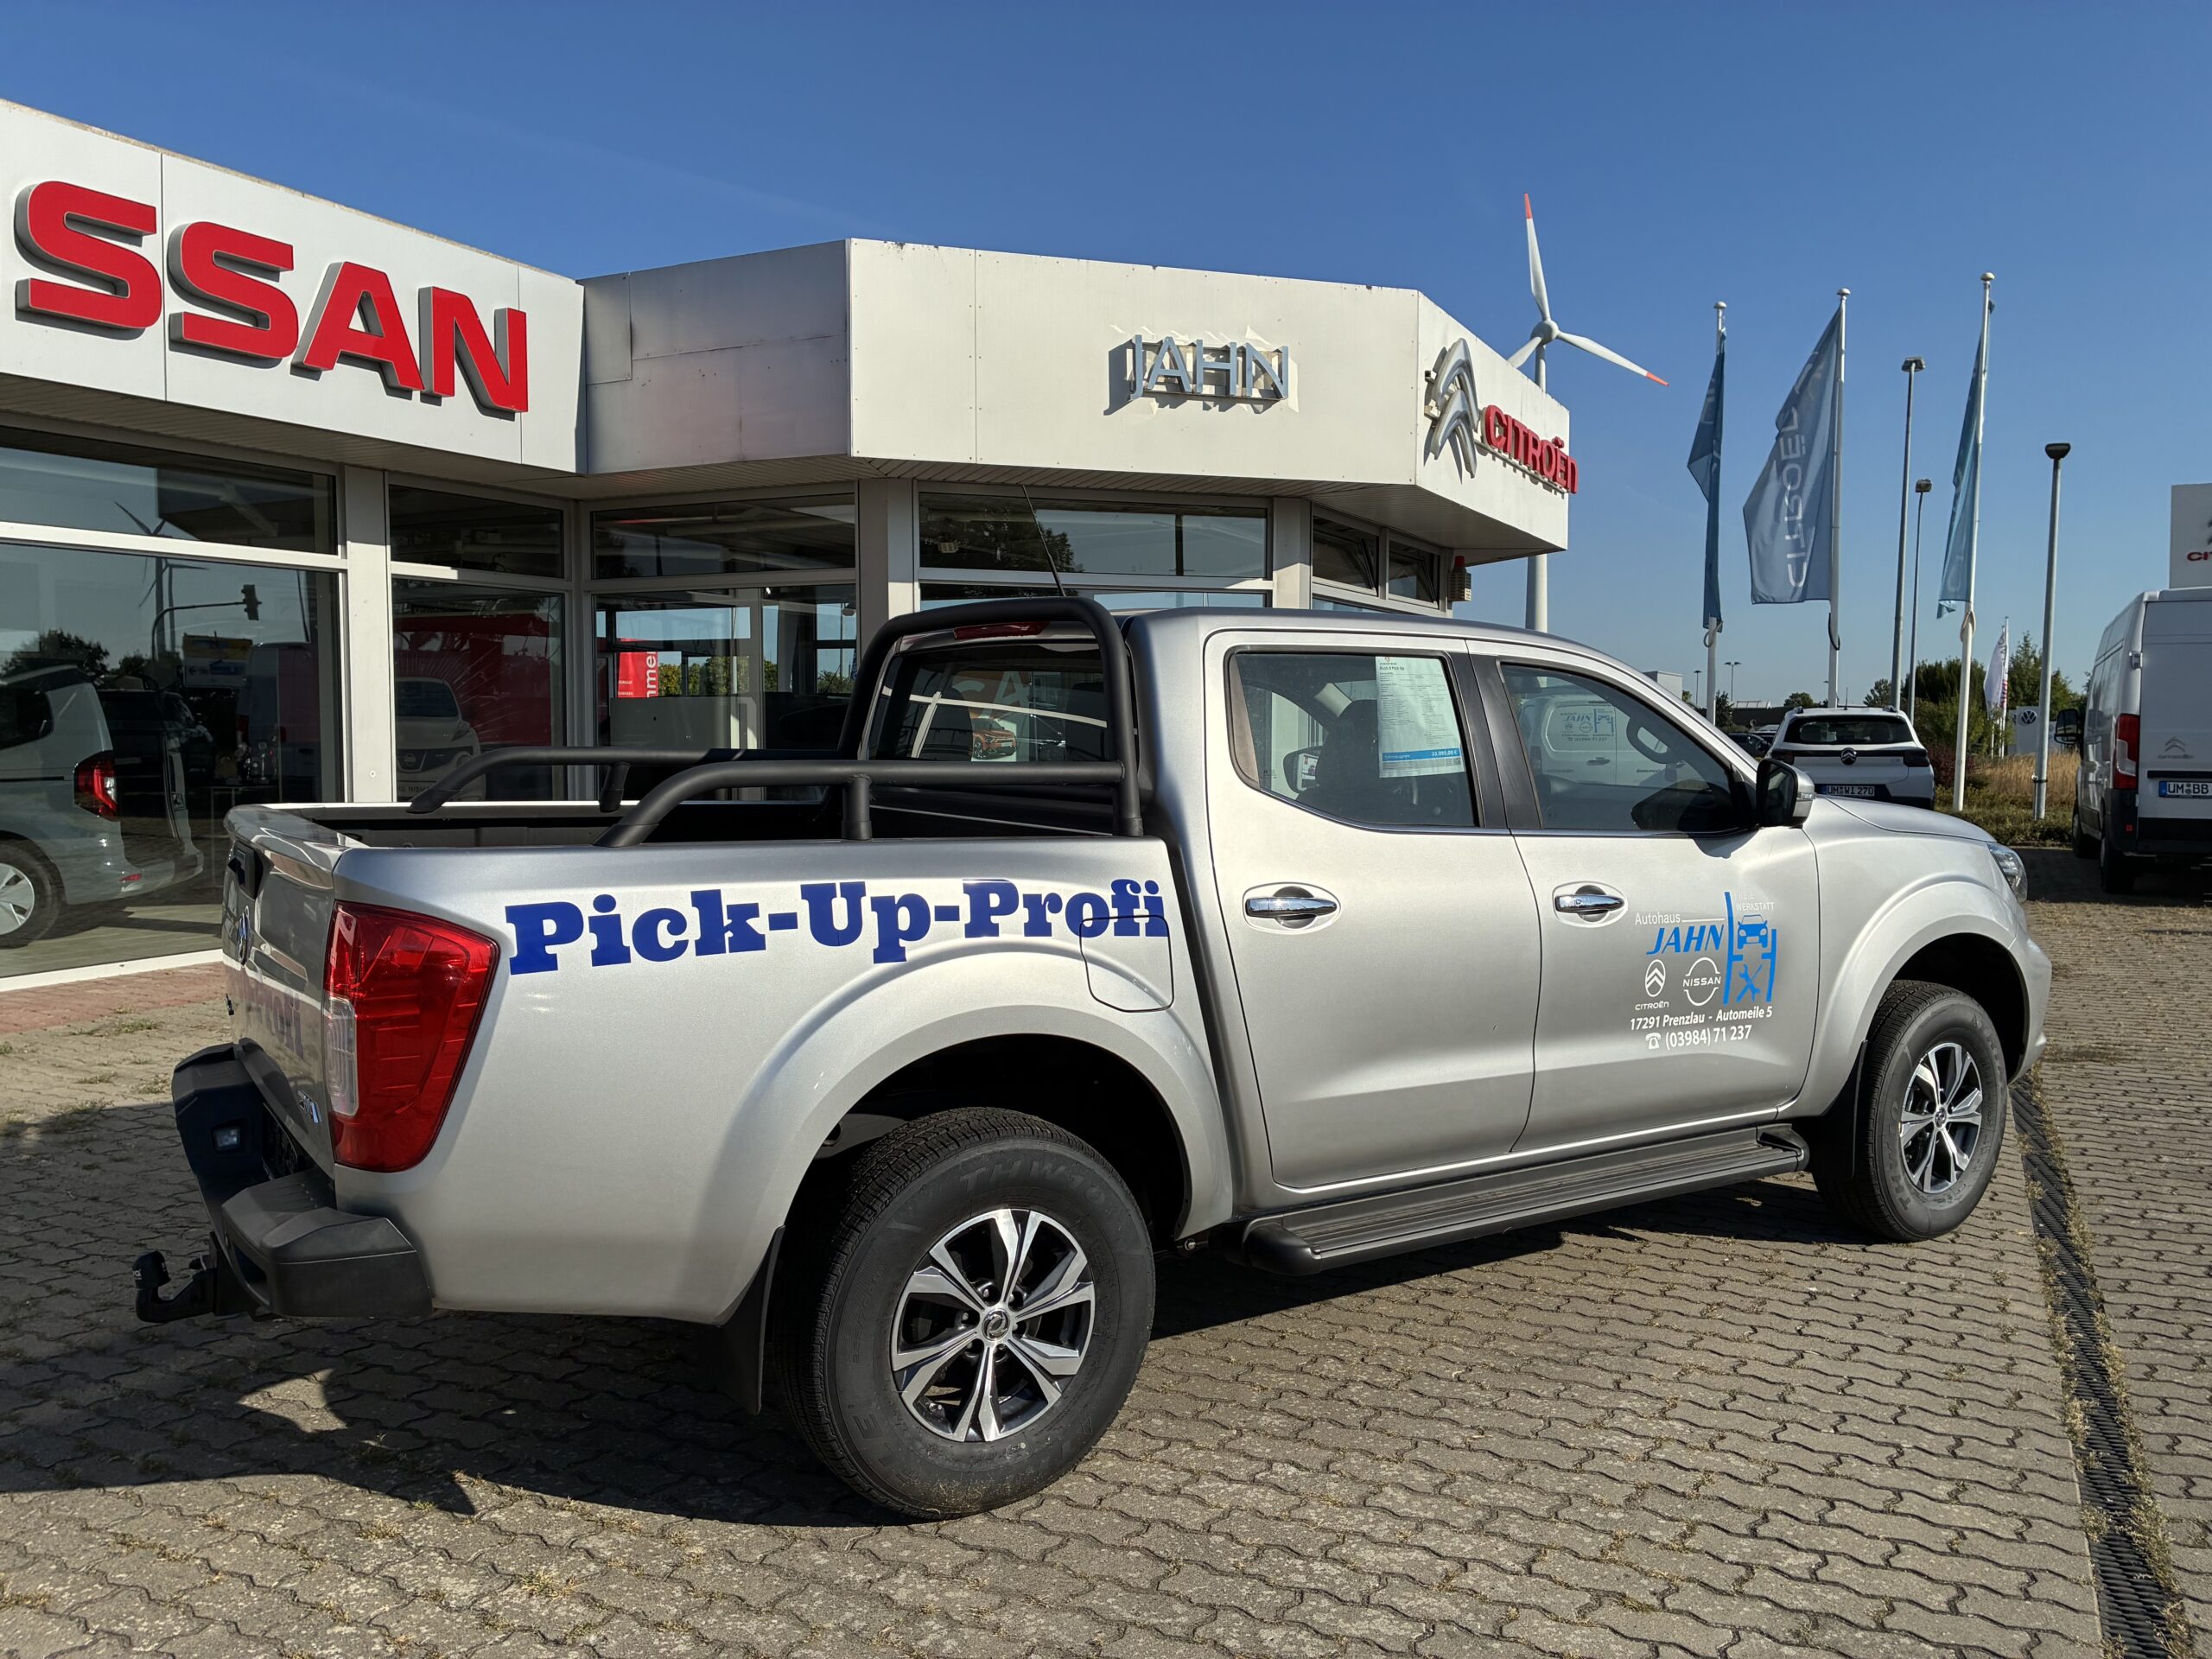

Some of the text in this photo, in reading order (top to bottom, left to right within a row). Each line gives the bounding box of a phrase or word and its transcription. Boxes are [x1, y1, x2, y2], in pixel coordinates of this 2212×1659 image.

[16, 180, 529, 414] SSAN
[1128, 334, 1289, 401] JAHN
[2187, 551, 2212, 562] CI
[1857, 786, 1874, 795] 270
[2169, 783, 2209, 795] UM BB
[1735, 901, 1776, 912] WERKSTATT
[505, 878, 1169, 975] Pick-Up-Profi
[1635, 912, 1681, 925] Autohaus
[1646, 925, 1725, 955] JAHN
[1682, 976, 1721, 988] NISSAN
[1630, 1016, 1661, 1031] 17291
[1662, 1012, 1705, 1027] Prenzlau
[1716, 1006, 1764, 1022] Automeile
[1765, 1006, 1773, 1018] 5
[1665, 1025, 1752, 1051] (03984) 71 237
